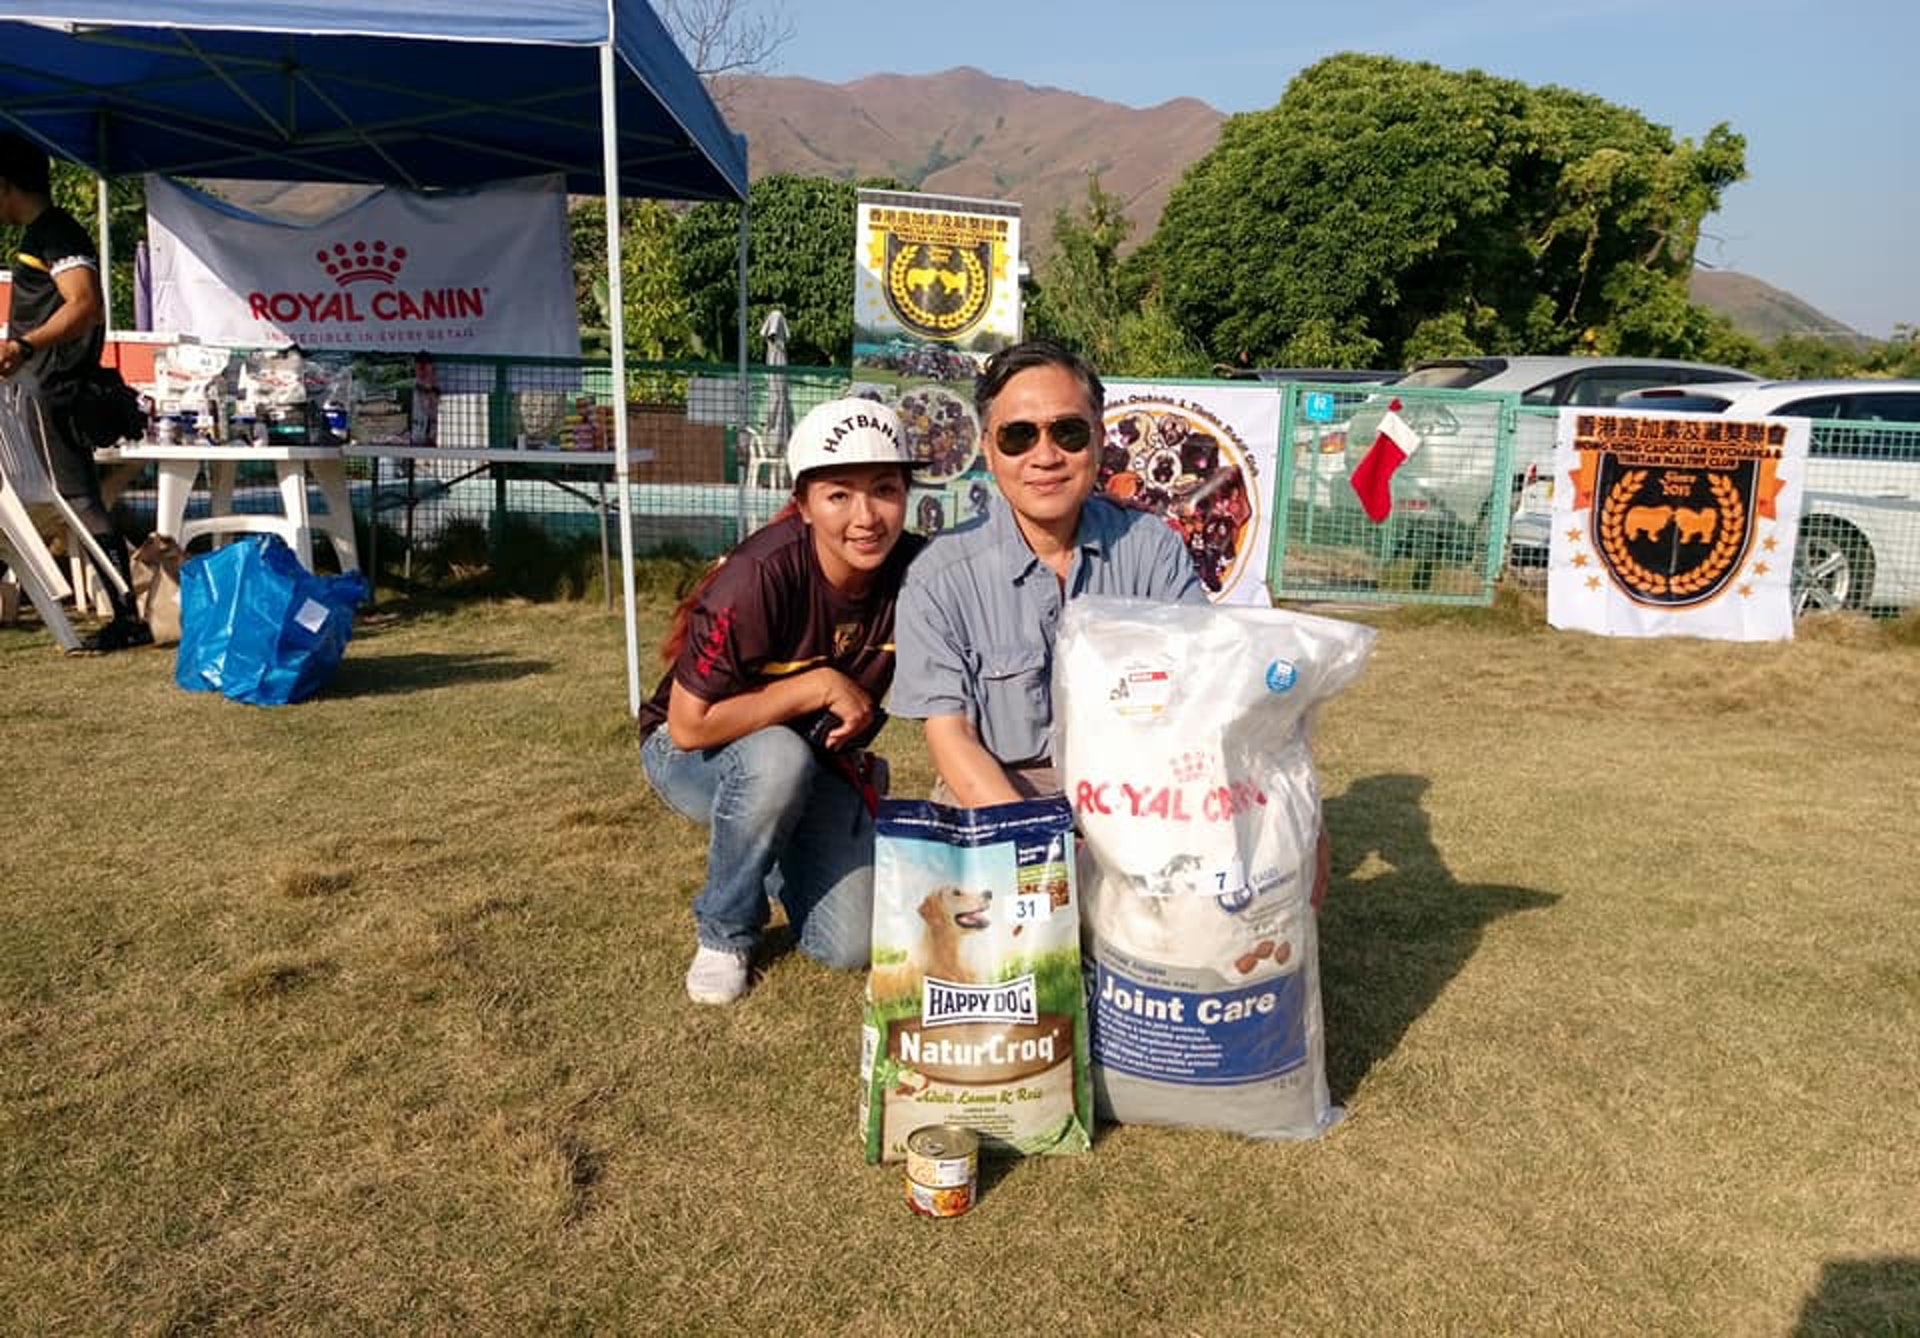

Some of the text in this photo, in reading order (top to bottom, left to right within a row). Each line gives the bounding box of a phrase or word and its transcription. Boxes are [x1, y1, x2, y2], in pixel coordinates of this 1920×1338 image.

[250, 288, 483, 322] ROYAL CANIN
[1215, 872, 1227, 889] 7
[1016, 901, 1036, 918] 31
[928, 985, 1032, 1017] HAPPY DOG
[1101, 975, 1185, 1024] Joint
[1197, 992, 1277, 1025] Care
[900, 1031, 1054, 1066] NaturCroq
